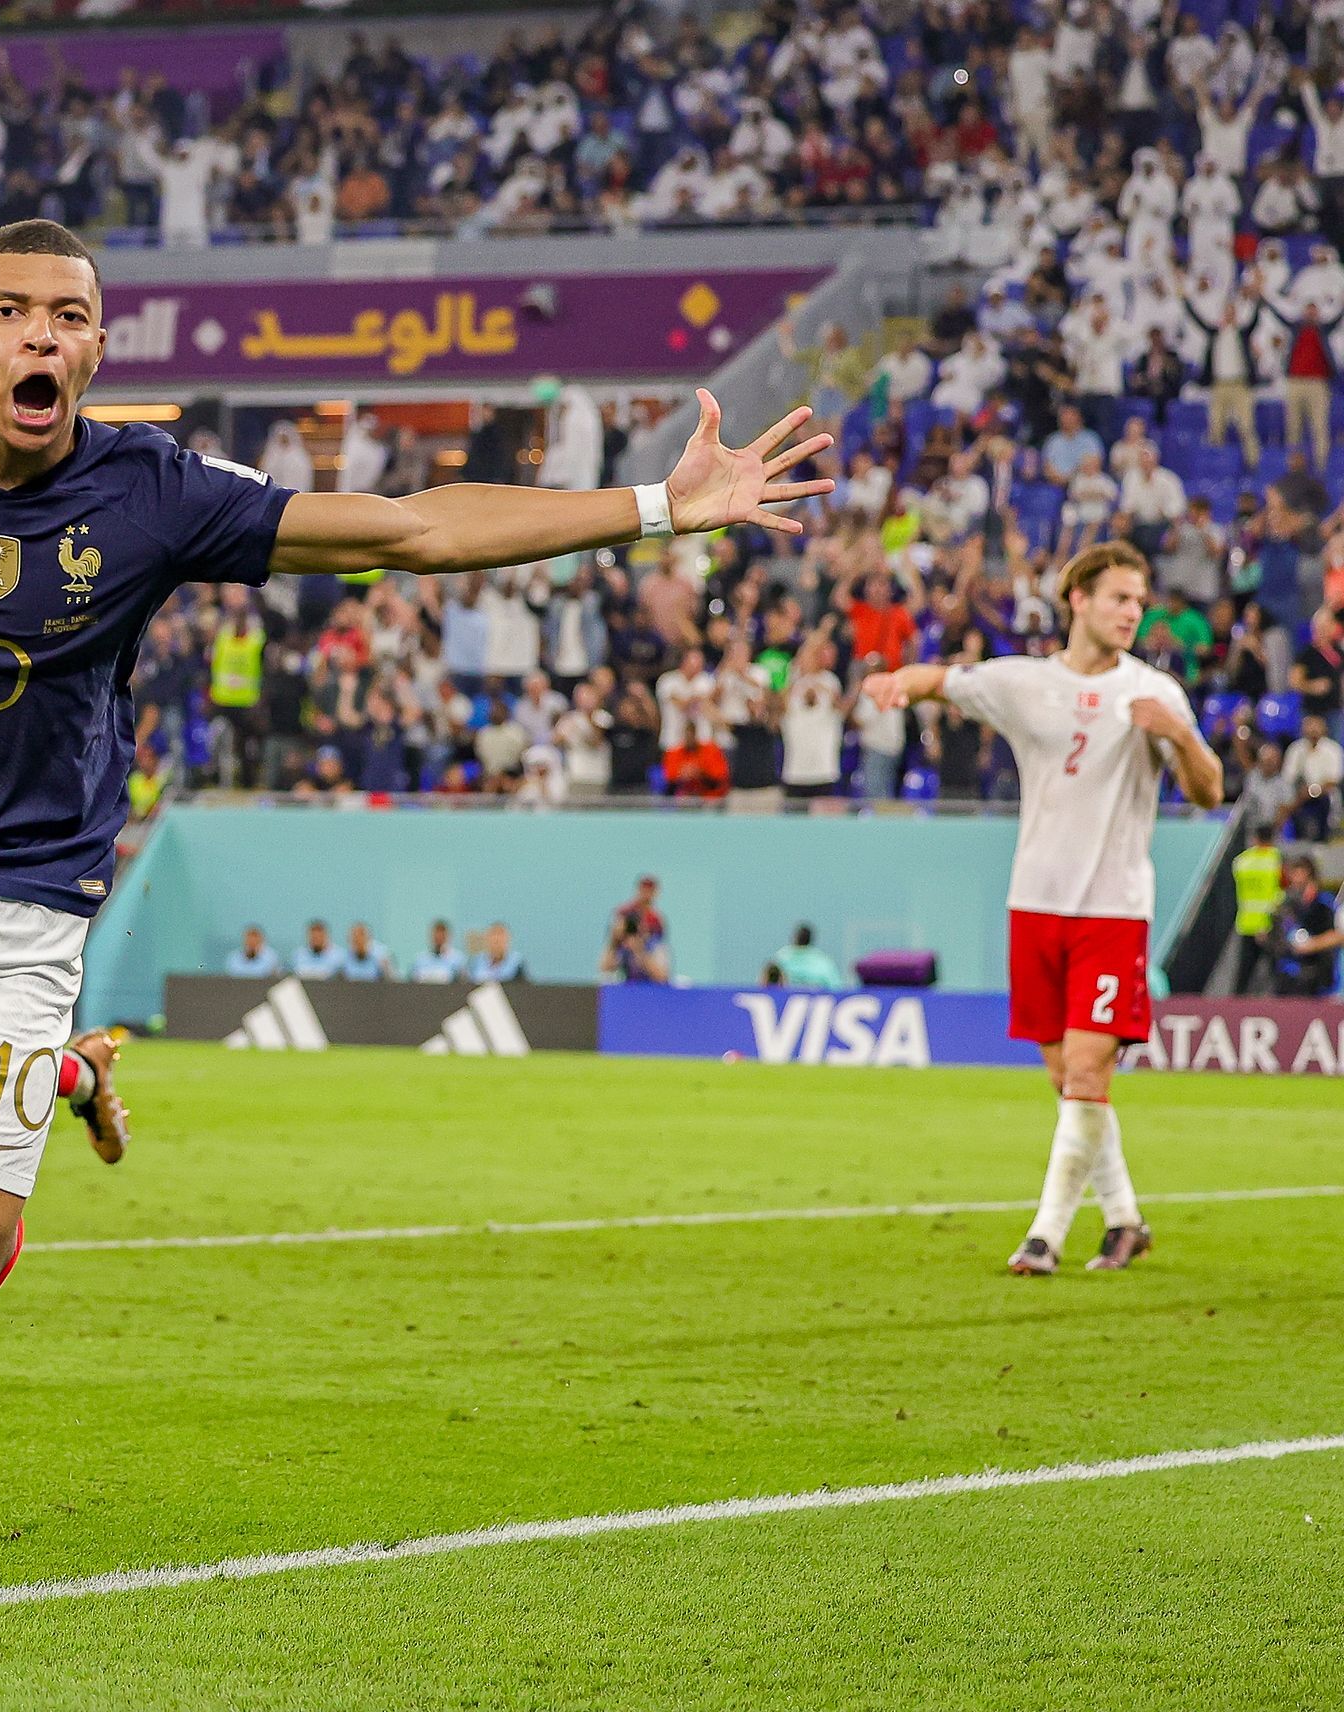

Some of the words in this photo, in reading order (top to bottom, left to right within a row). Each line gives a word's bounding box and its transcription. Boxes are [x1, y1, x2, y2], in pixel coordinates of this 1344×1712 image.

[1064, 733, 1088, 775] 2
[1091, 974, 1120, 1024] 2
[732, 992, 931, 1067] VISA
[1117, 1015, 1282, 1074] ATAR
